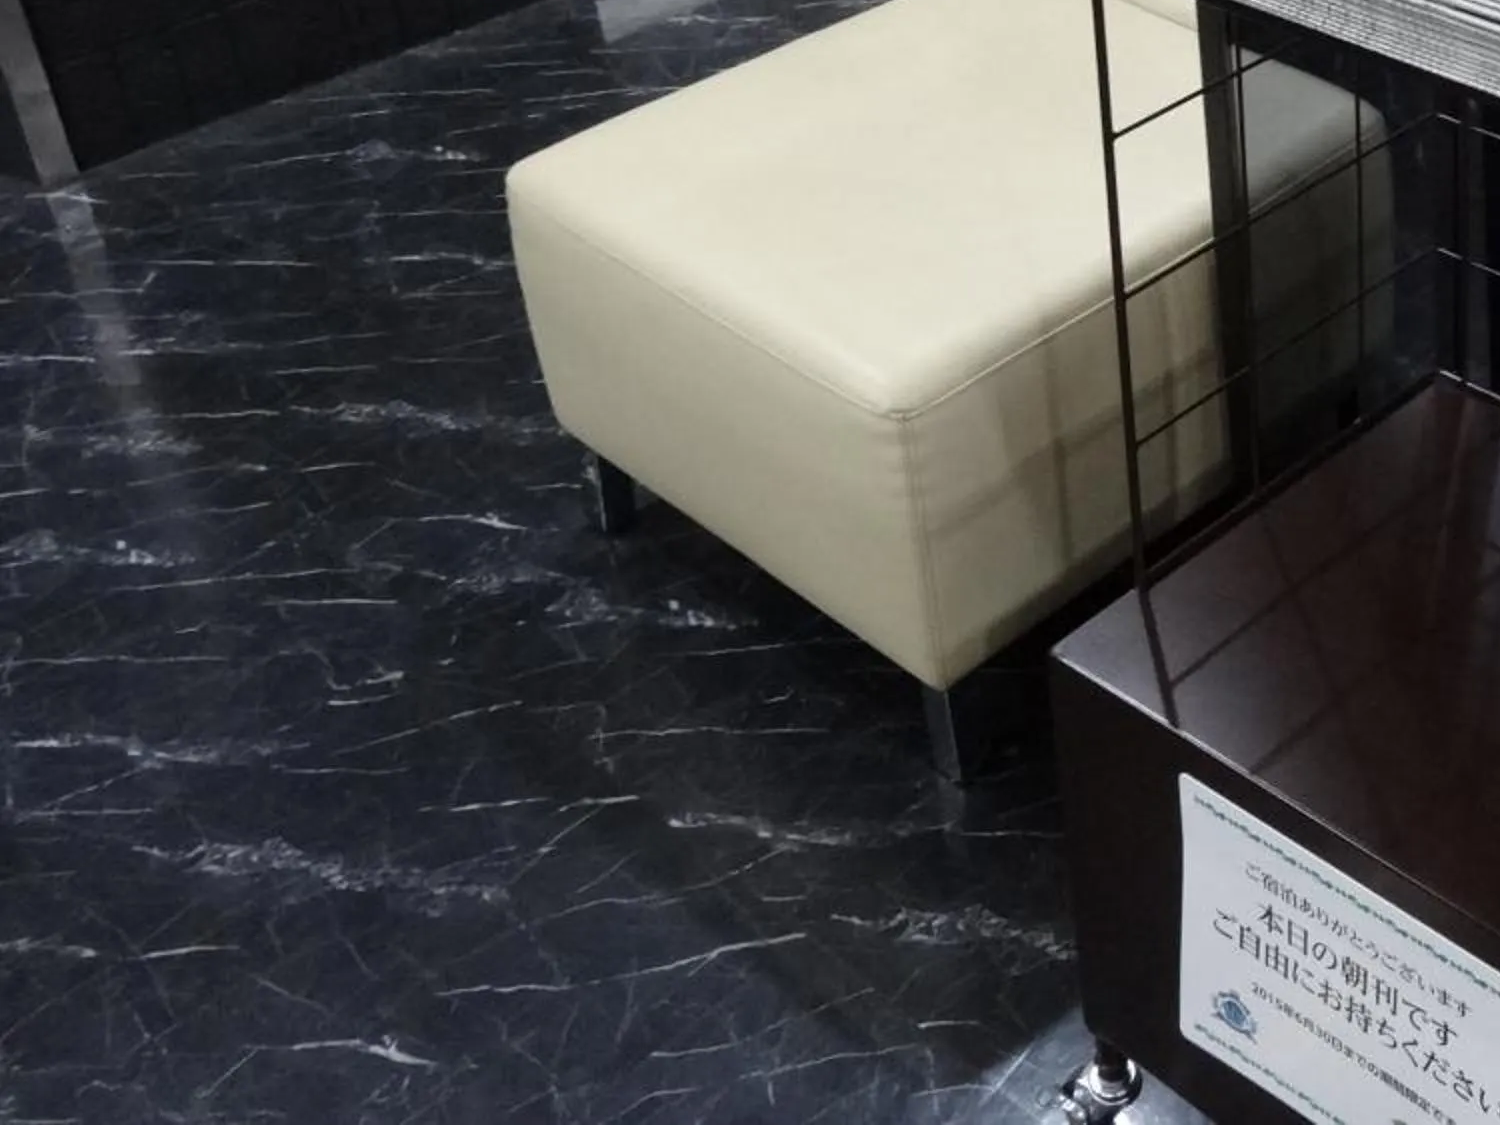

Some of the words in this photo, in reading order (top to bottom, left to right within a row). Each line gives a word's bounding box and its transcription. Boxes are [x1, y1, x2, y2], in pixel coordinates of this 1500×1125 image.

[1243, 862, 1474, 1019] ご宿泊ありがとうございます
[1257, 901, 1461, 1048] 本日の朝刊です
